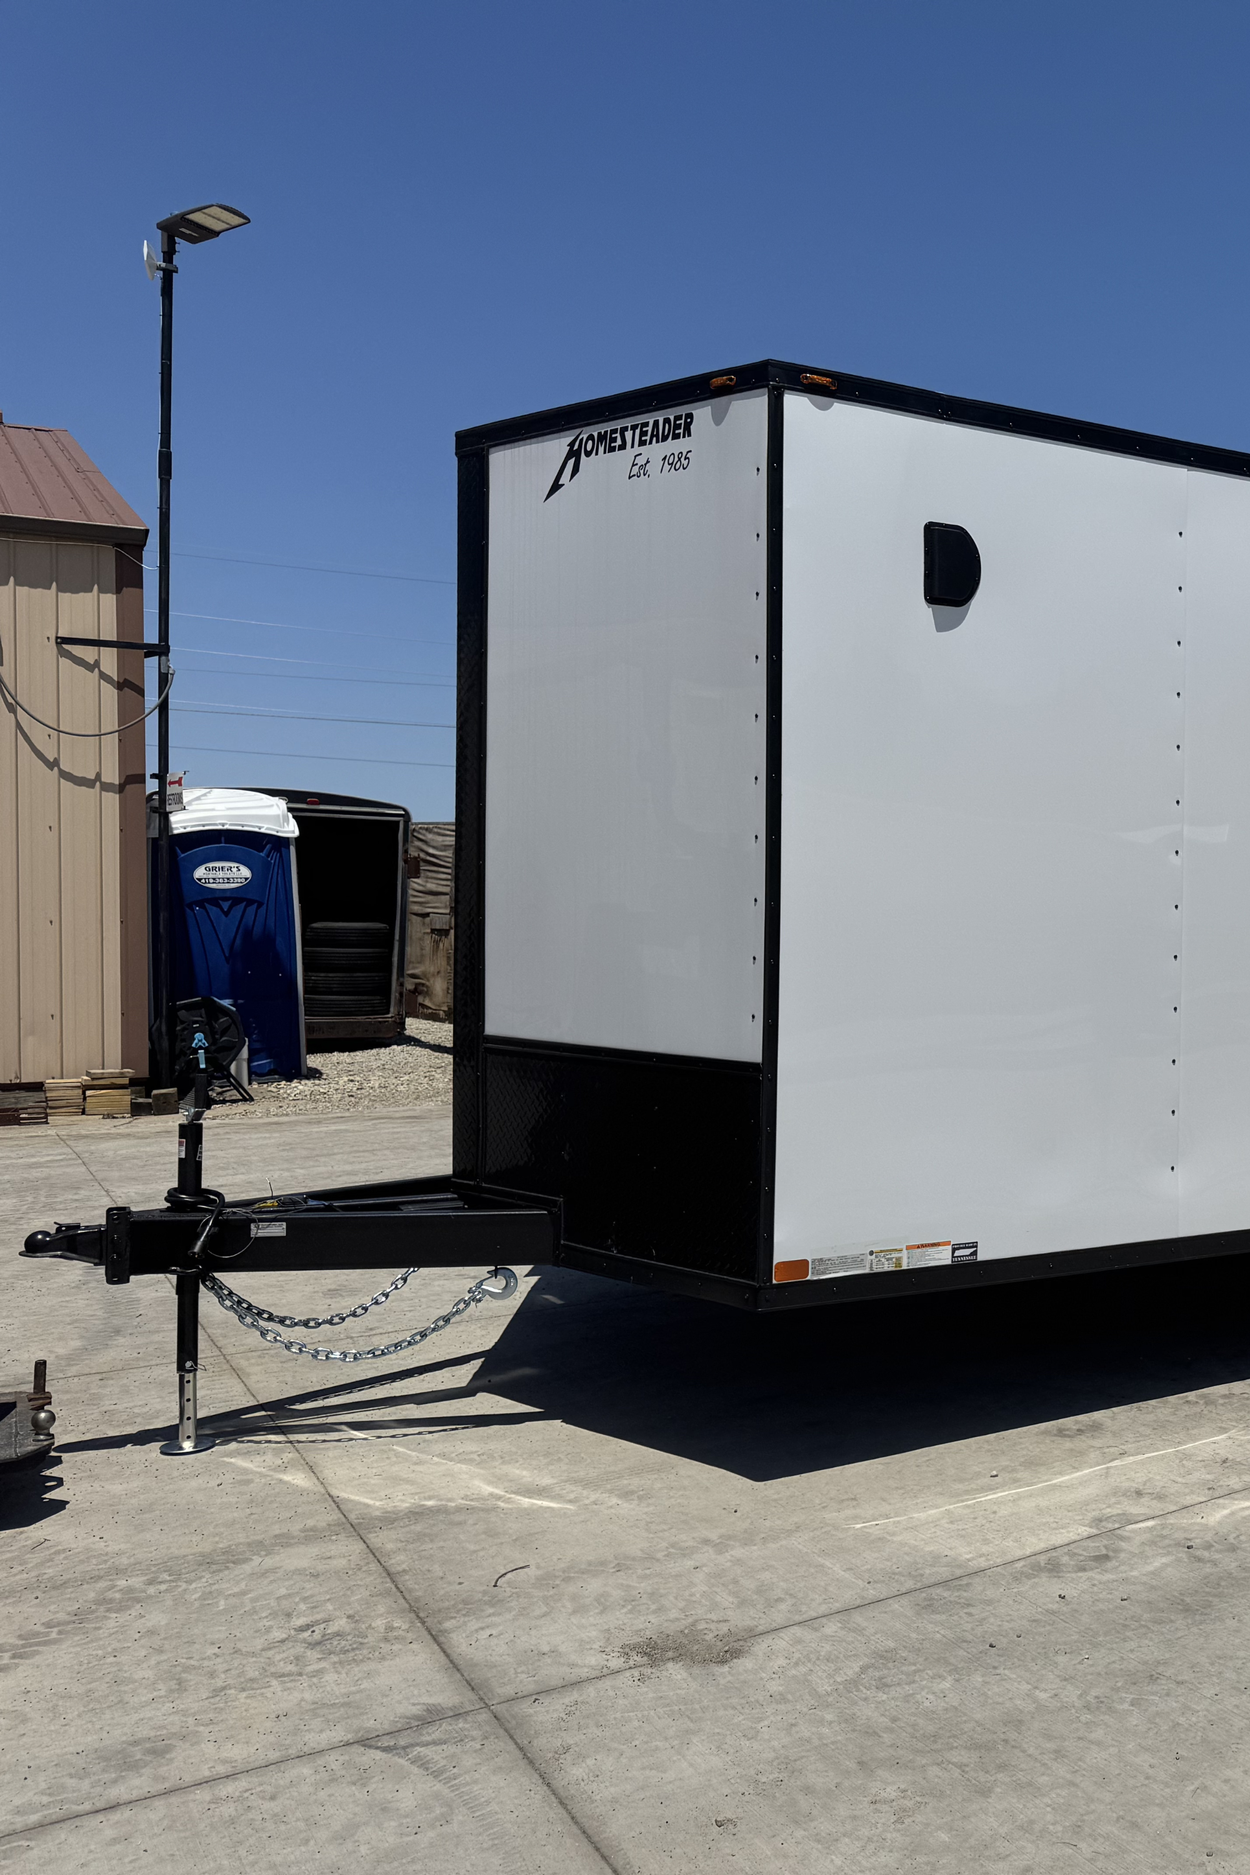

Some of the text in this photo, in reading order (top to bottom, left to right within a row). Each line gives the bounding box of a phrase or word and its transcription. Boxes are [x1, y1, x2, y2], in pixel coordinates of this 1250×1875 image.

[543, 412, 694, 503] HOMESTEADER
[628, 450, 692, 480] Est. 1985
[204, 865, 241, 873] GRIER'S
